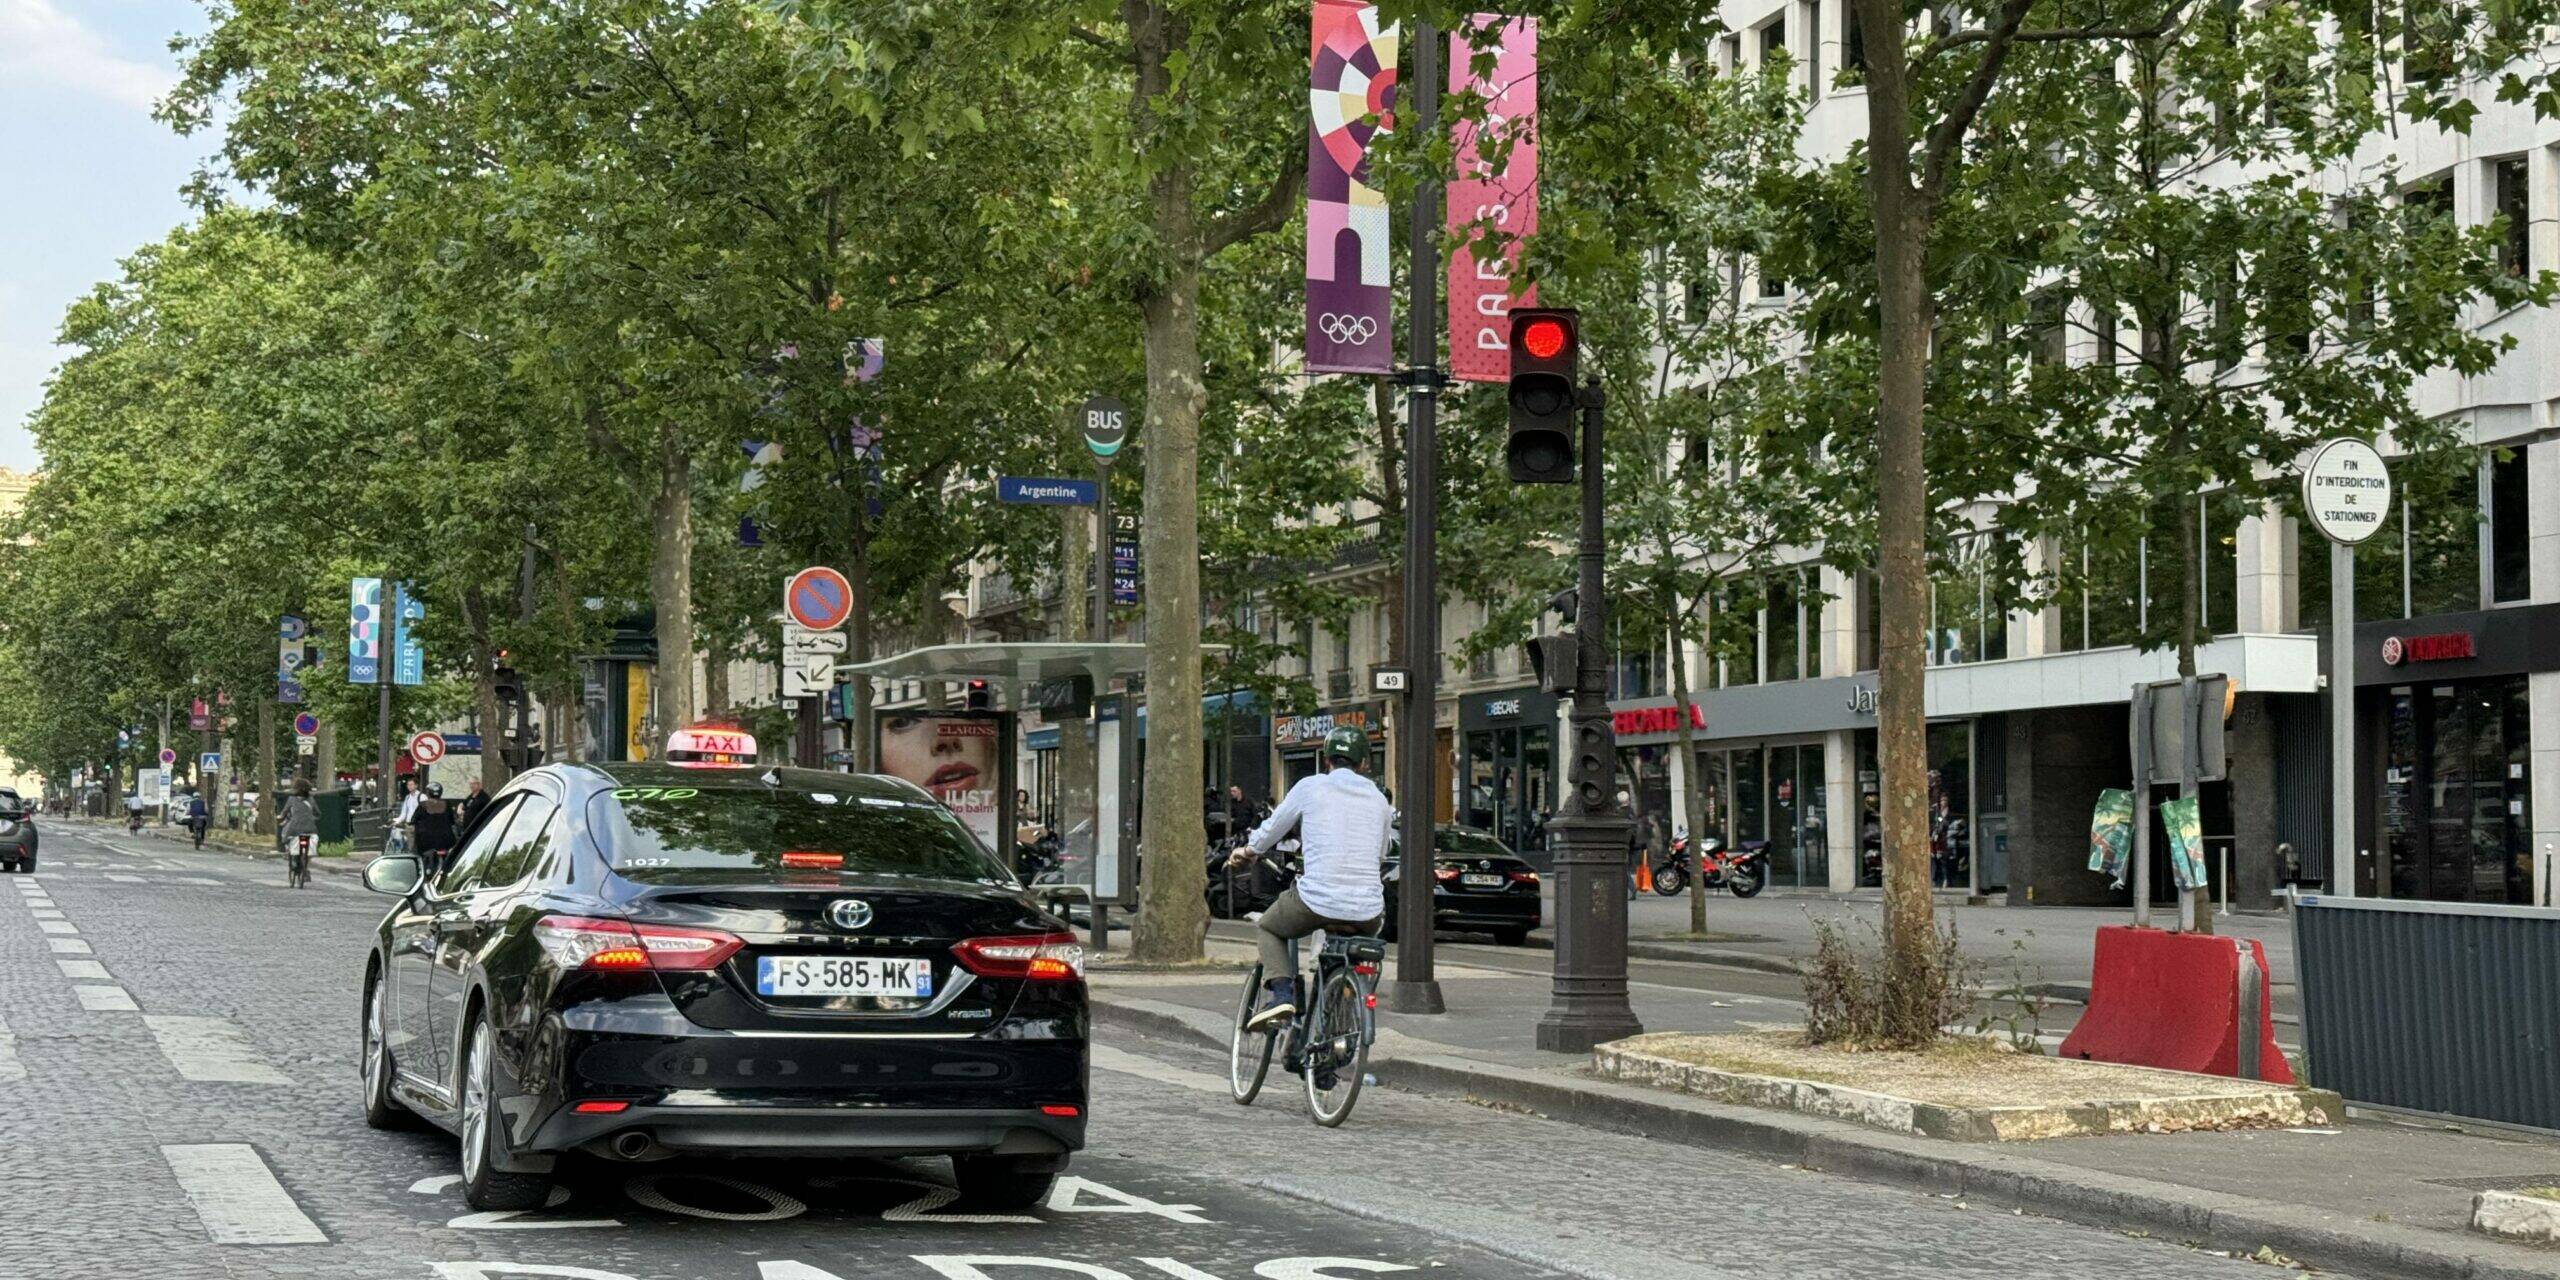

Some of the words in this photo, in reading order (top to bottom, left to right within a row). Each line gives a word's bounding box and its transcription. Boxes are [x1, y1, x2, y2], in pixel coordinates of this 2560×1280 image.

[1476, 203, 1509, 350] PARS
[1087, 410, 1122, 429] BUS
[2343, 460, 2358, 471] FIN
[2316, 476, 2385, 489] D'INTERDICTION
[1019, 485, 1077, 499] Argentine
[2345, 494, 2357, 505] DE
[1116, 515, 1135, 529] 73
[2324, 511, 2377, 522] STATIONNER
[1383, 675, 1398, 686] 49
[938, 725, 994, 735] CLARINS
[691, 735, 741, 751] TAXI
[945, 790, 993, 807] JUST
[966, 802, 994, 813] balm
[624, 858, 670, 867] 1027
[779, 960, 911, 989] FS-585-MK
[917, 979, 931, 990] 91
